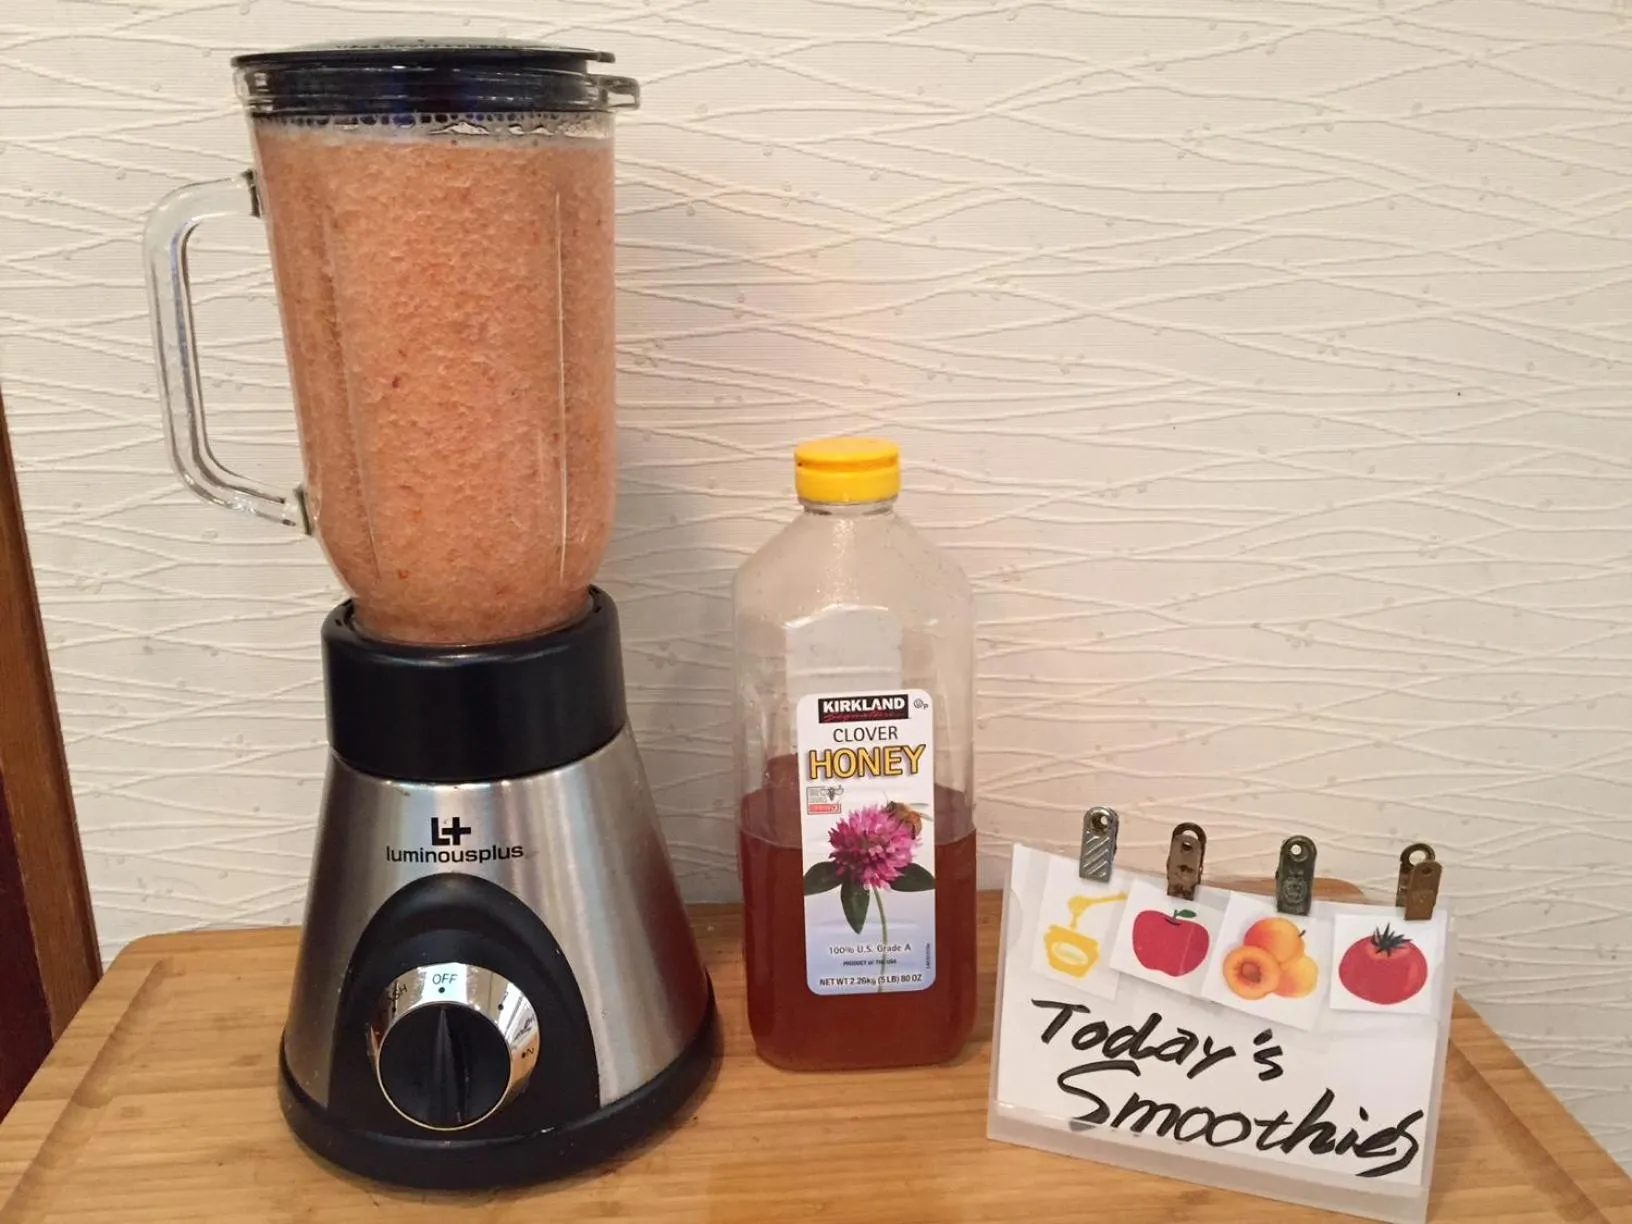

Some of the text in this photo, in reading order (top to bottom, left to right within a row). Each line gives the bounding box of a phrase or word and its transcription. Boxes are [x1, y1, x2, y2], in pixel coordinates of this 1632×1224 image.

[823, 698, 905, 713] KIRKLAND
[833, 726, 898, 742] CLOVER
[809, 744, 926, 779] HONEY
[386, 845, 524, 864] luminousplus
[829, 946, 854, 954] 100%
[877, 944, 901, 952] Grade
[904, 943, 911, 951] A
[432, 973, 458, 985] OFF
[820, 978, 835, 986] NET
[836, 977, 848, 985] WT
[911, 974, 922, 982] OZ
[1030, 998, 1285, 1082] Today's
[1057, 1060, 1424, 1178] Smoothies
